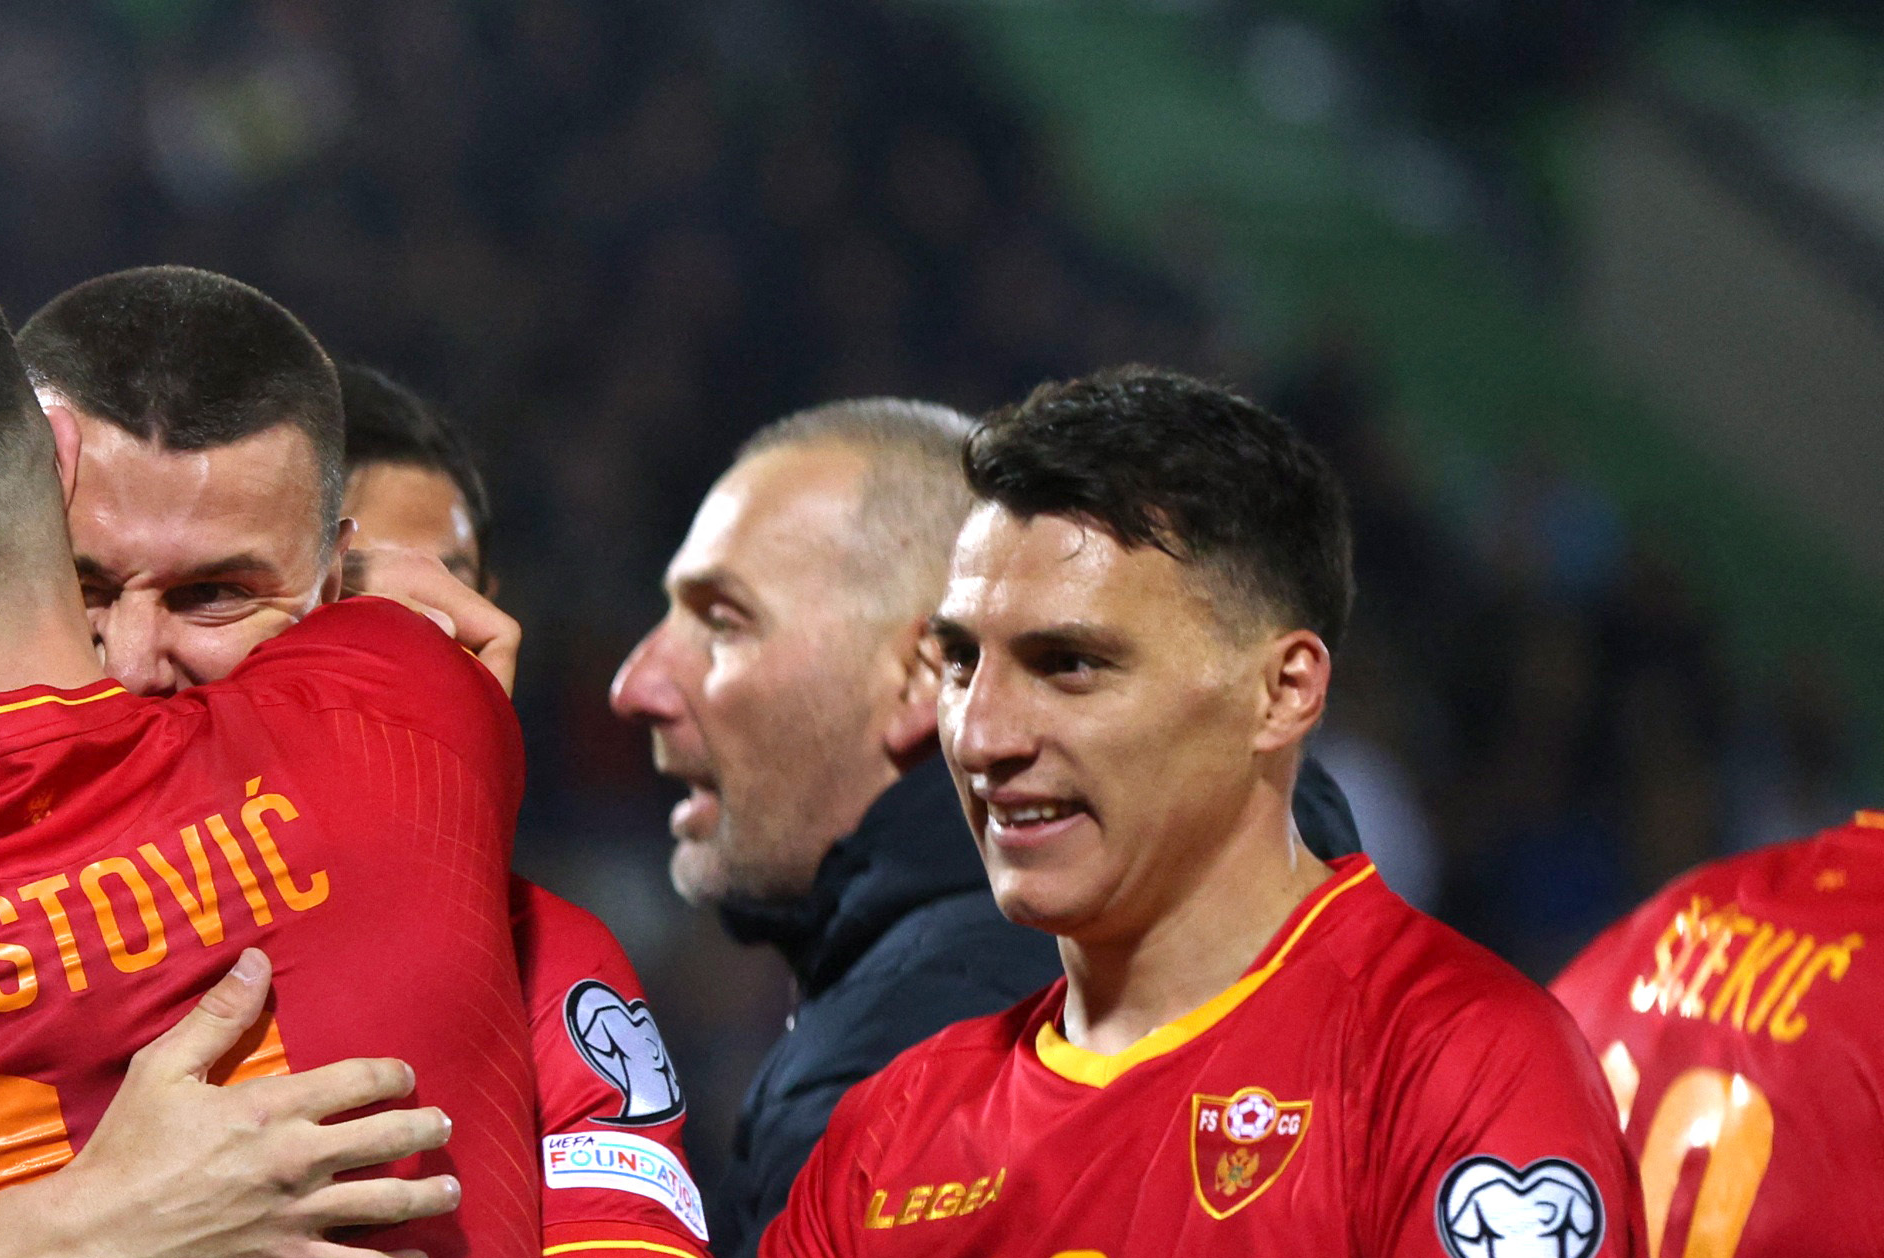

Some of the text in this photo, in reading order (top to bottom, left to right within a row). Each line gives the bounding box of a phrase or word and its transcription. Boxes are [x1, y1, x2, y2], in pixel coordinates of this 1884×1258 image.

[1199, 1108, 1301, 1135] FS CG
[549, 1136, 595, 1149] UEFA
[549, 1150, 703, 1221] FOUNDATION
